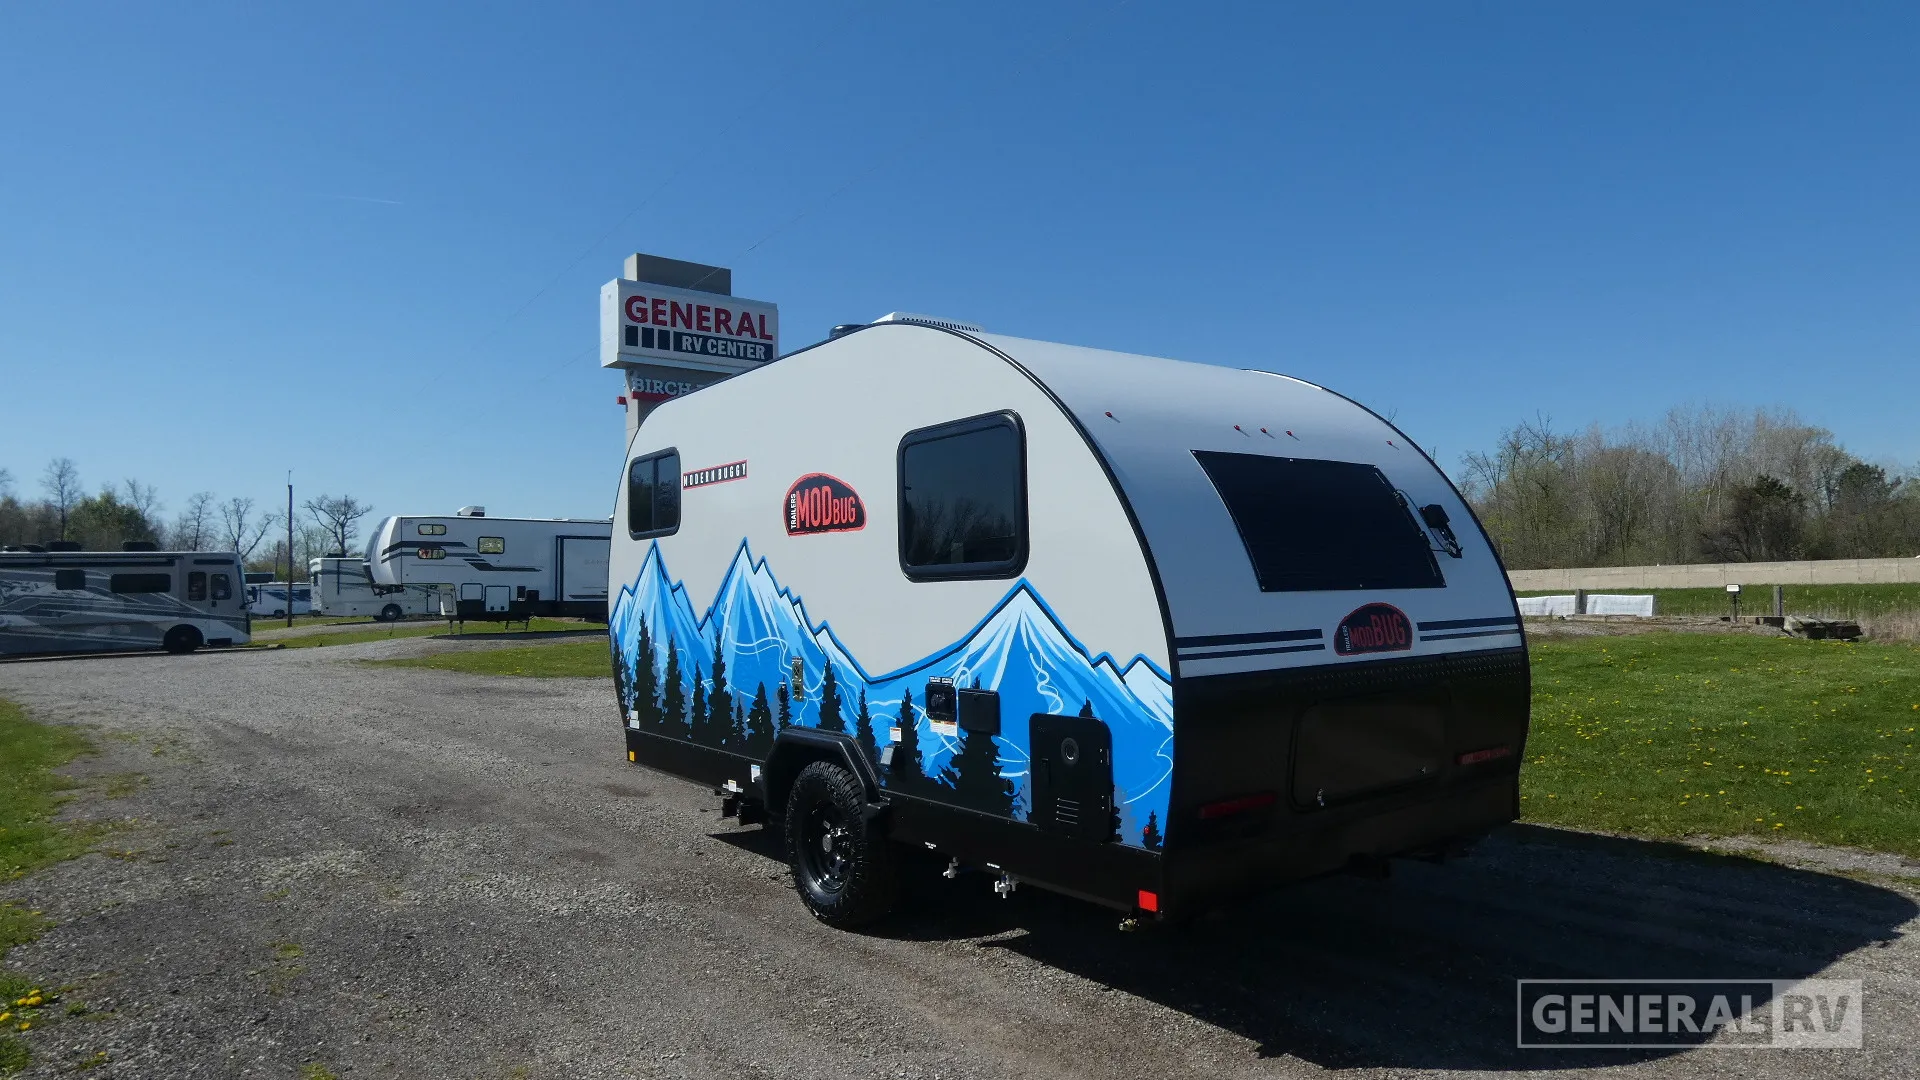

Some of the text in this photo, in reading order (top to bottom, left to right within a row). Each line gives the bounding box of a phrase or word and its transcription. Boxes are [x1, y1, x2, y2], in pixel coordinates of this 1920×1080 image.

[625, 295, 773, 340] GENERAL
[682, 335, 766, 360] RV CENTER
[631, 377, 692, 396] BIRCH
[683, 463, 746, 487] MODERN BUGGY
